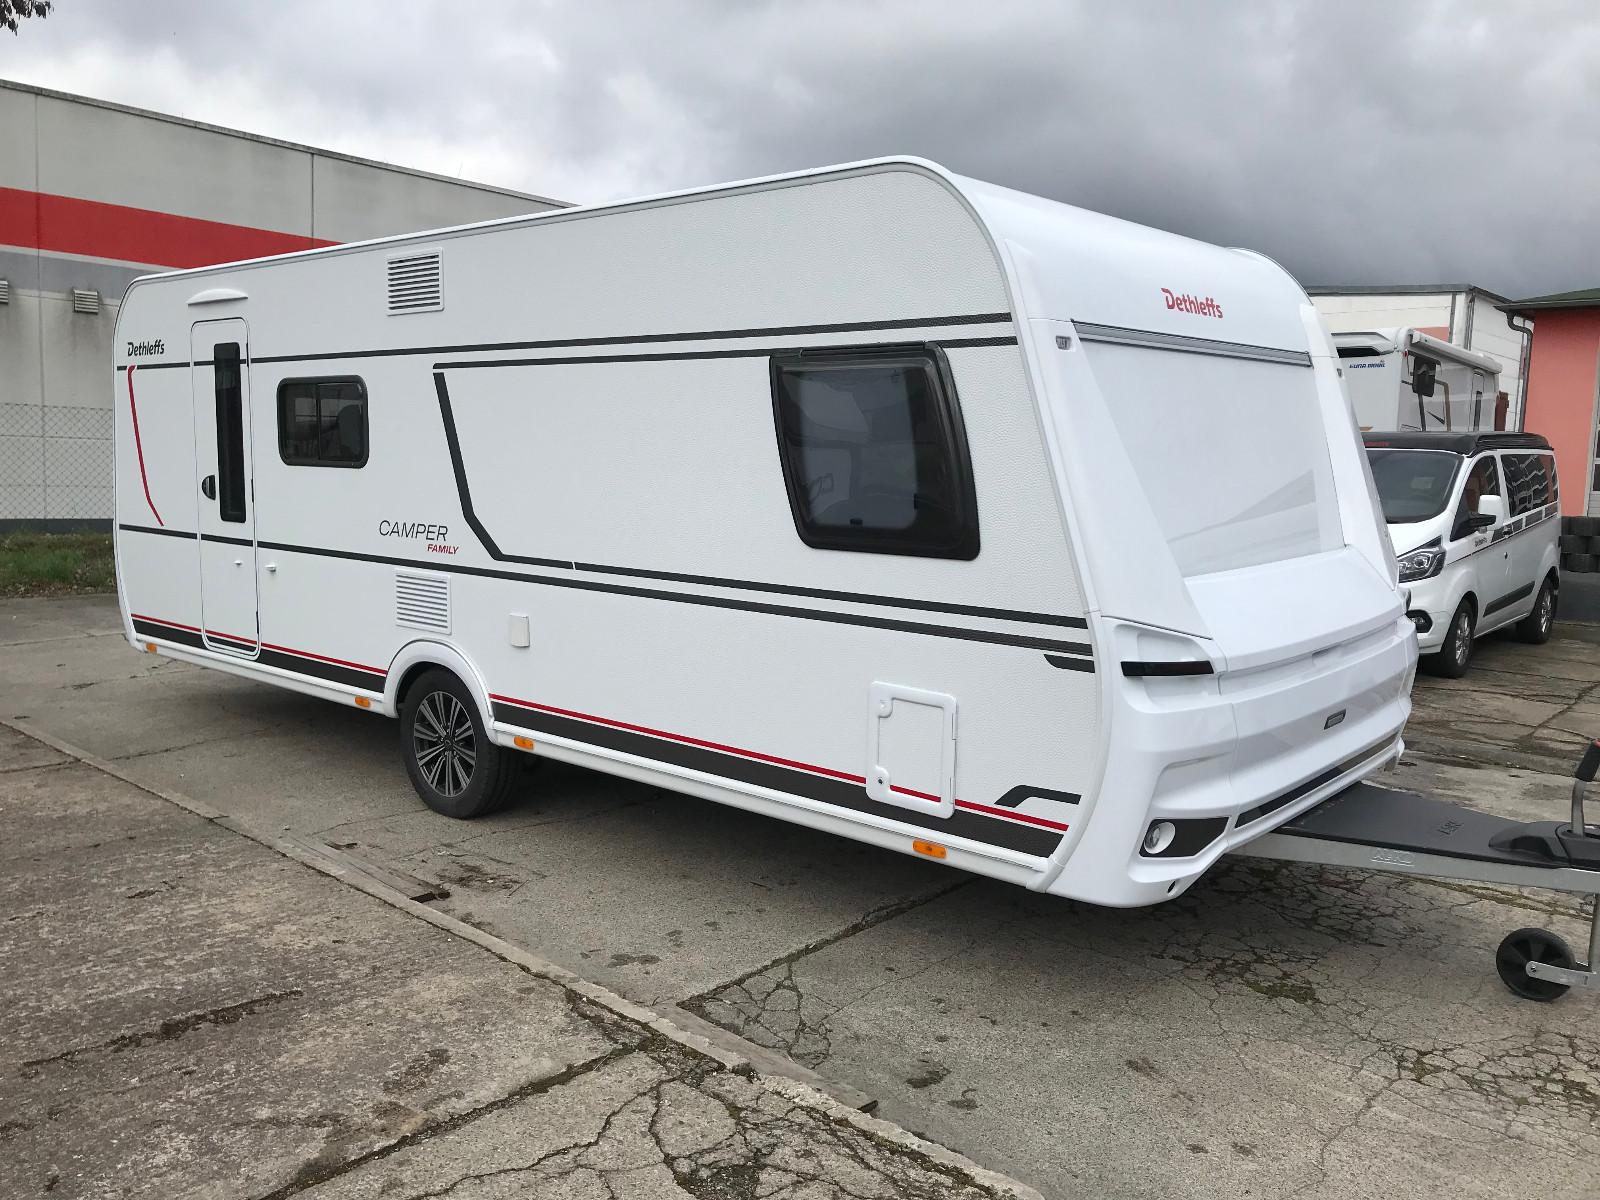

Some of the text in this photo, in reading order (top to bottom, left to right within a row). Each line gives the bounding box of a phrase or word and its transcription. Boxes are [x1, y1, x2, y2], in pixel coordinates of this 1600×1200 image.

[1161, 287, 1223, 318] Dethleffs
[127, 339, 165, 357] Dethleffs
[379, 520, 448, 541] CAMPER
[427, 543, 459, 555] FAMILY
